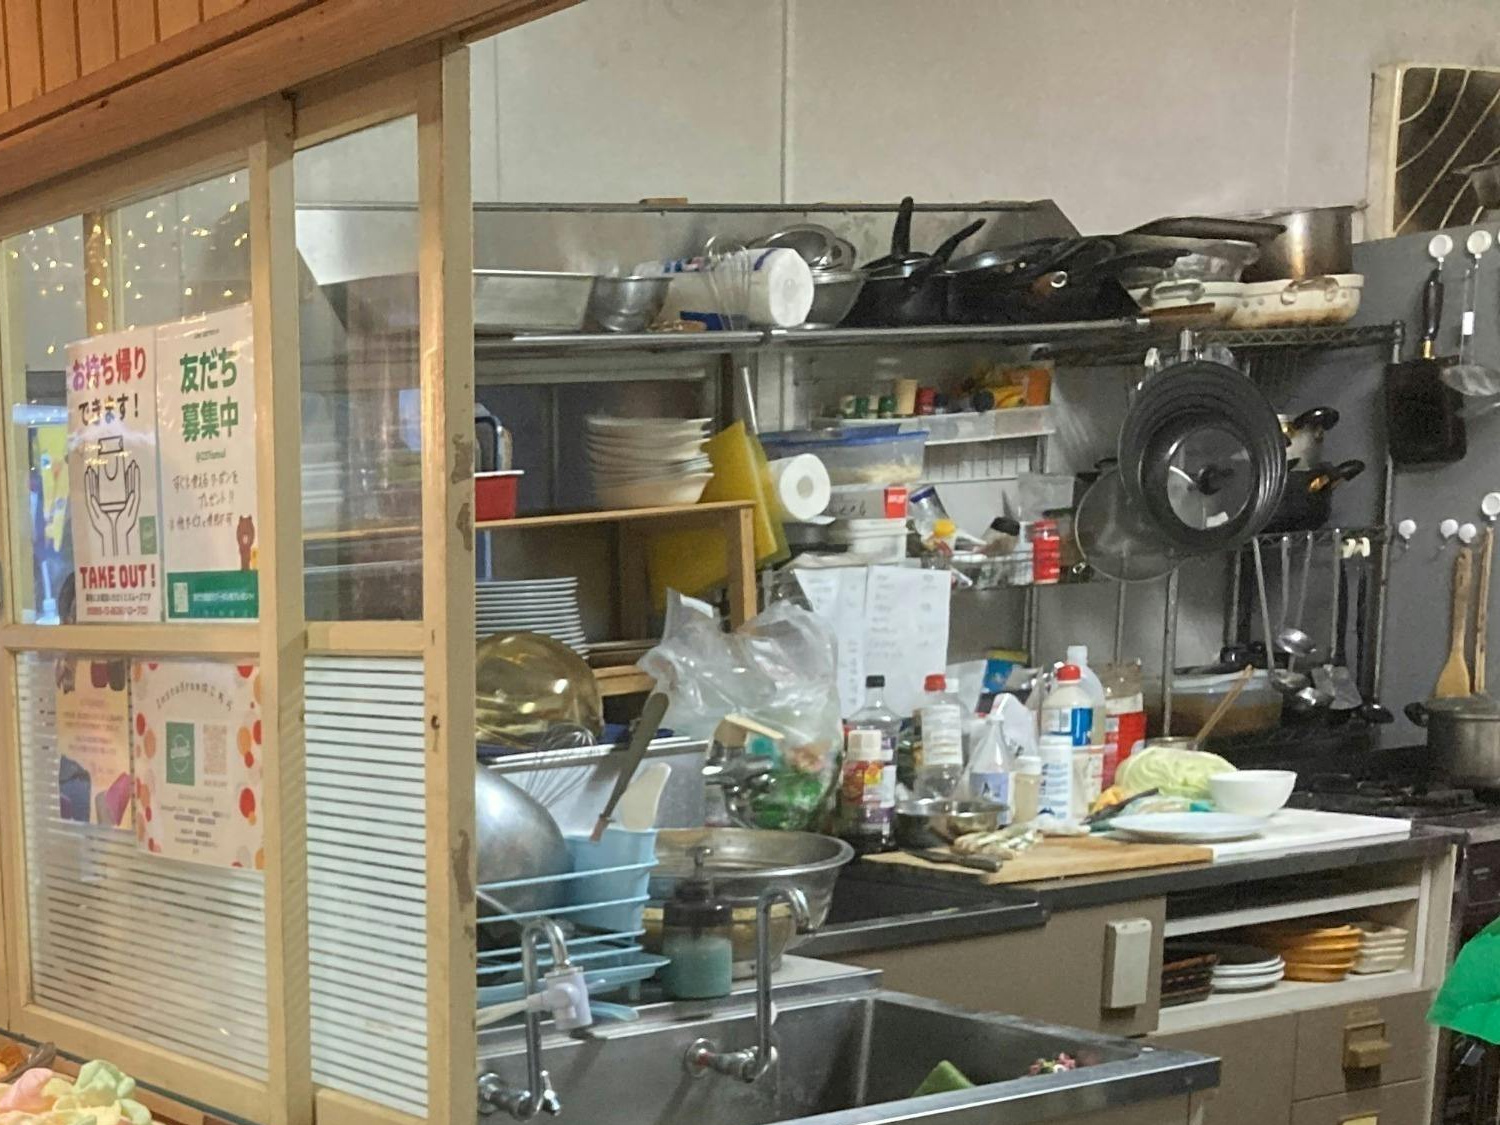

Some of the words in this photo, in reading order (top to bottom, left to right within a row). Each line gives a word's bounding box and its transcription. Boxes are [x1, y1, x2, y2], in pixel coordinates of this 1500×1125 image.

[72, 347, 147, 391] お持ち帰り
[179, 347, 238, 393] 友だち
[181, 396, 239, 442] 募集中
[79, 565, 116, 590] TAKE
